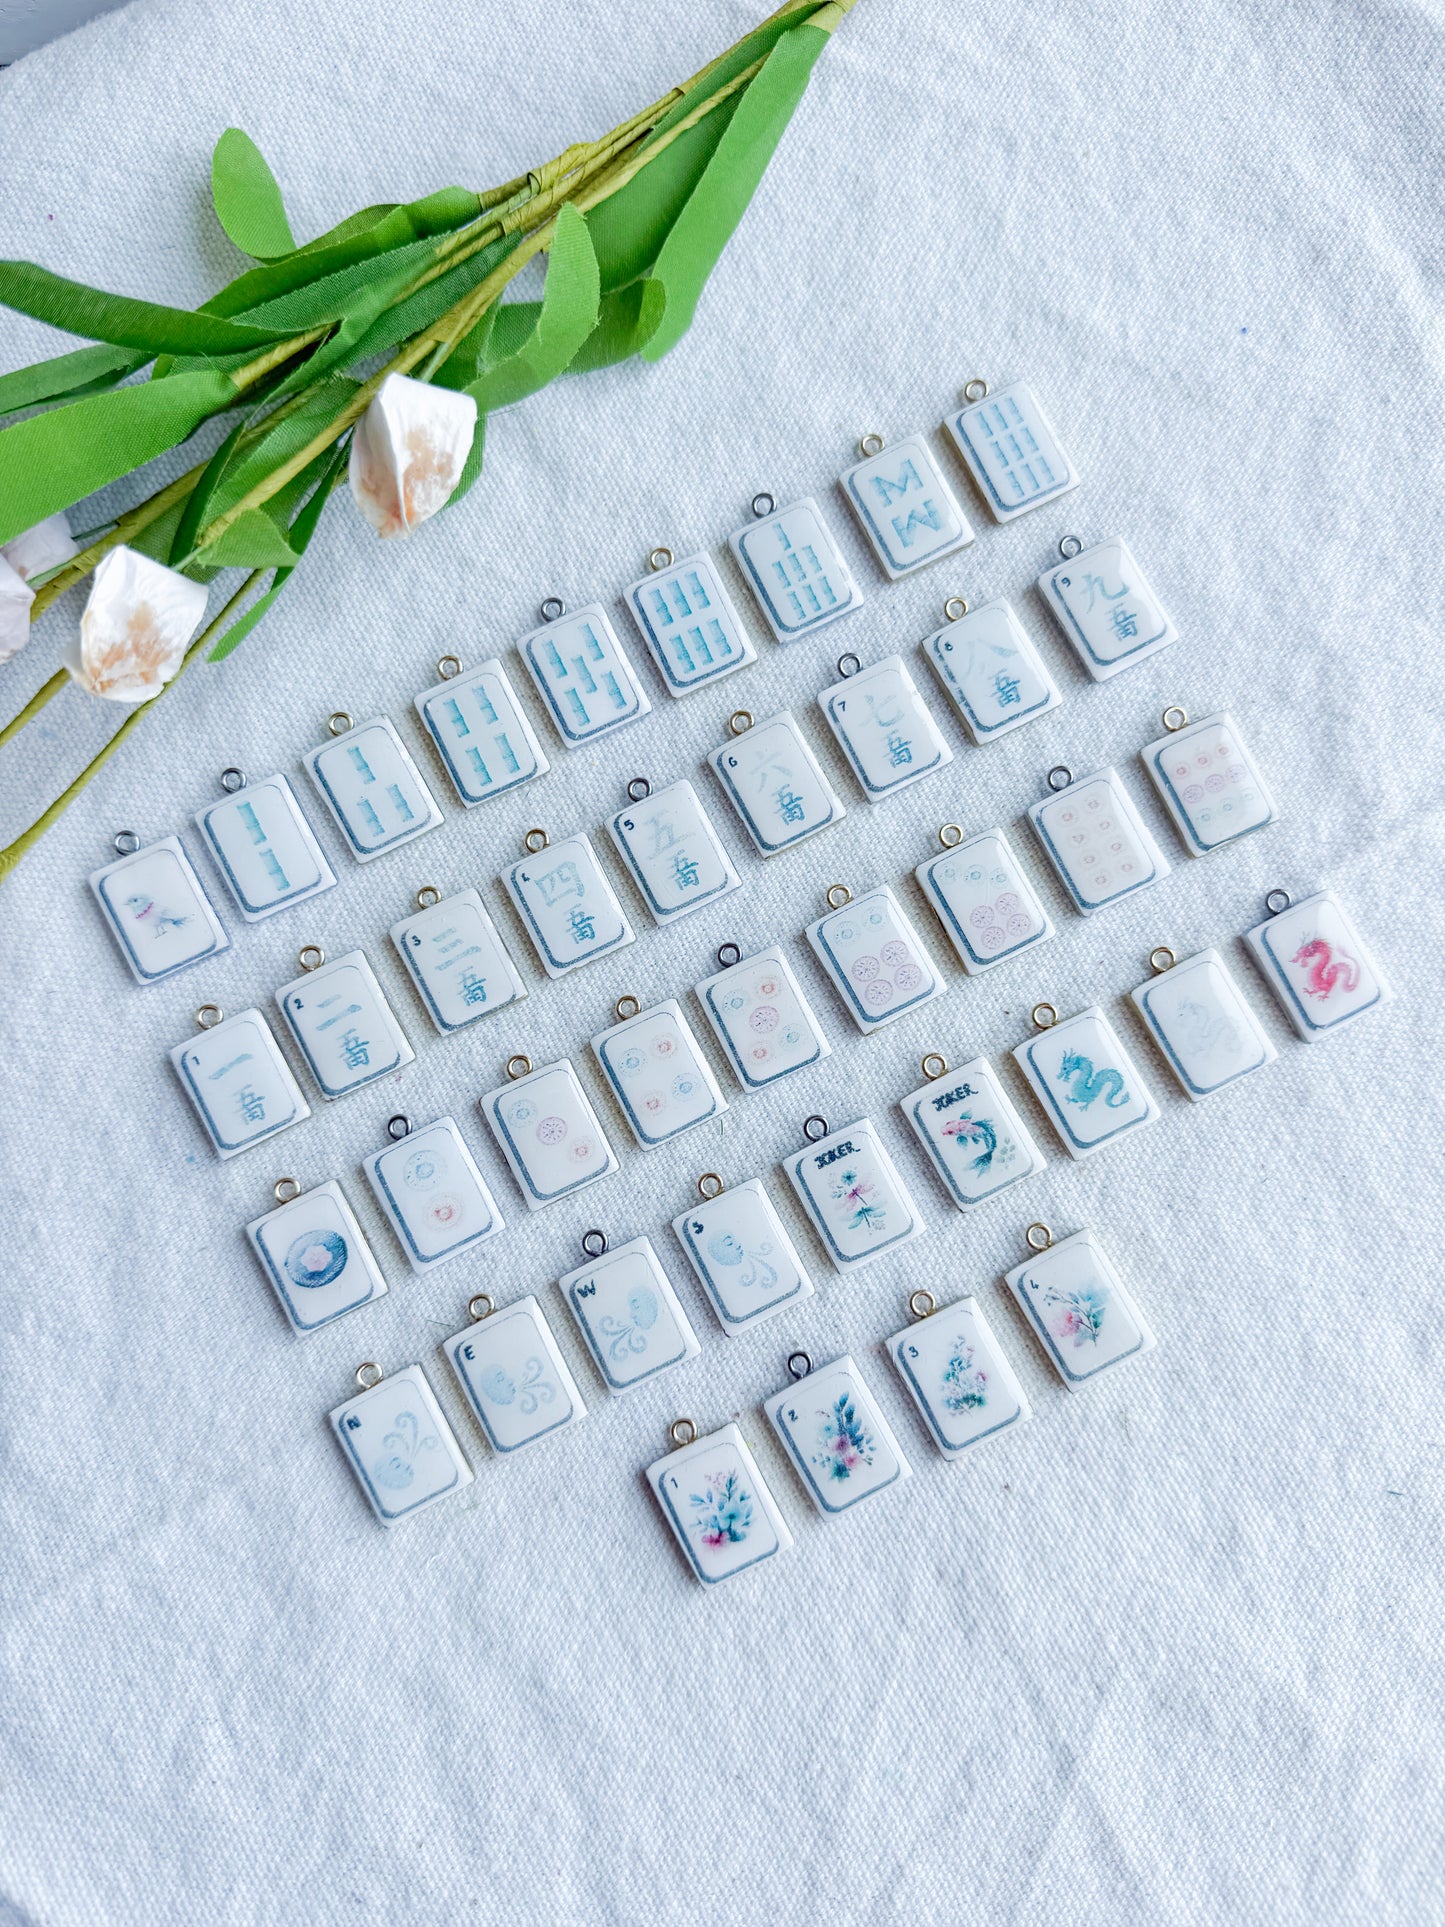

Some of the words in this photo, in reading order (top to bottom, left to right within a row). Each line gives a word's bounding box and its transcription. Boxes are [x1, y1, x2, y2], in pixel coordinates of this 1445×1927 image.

[837, 701, 847, 712] 7
[728, 756, 738, 768] 6
[624, 819, 635, 831] 5
[411, 935, 422, 947] 3
[294, 998, 304, 1010] 2
[191, 1056, 200, 1065] 1
[932, 1083, 979, 1112] JOKER
[814, 1140, 861, 1169] JOKER
[577, 1279, 596, 1298] W
[1030, 1279, 1039, 1289] 4
[464, 1345, 475, 1360] E
[909, 1346, 919, 1358] 3
[788, 1409, 798, 1422] 2
[671, 1477, 678, 1488] 1
